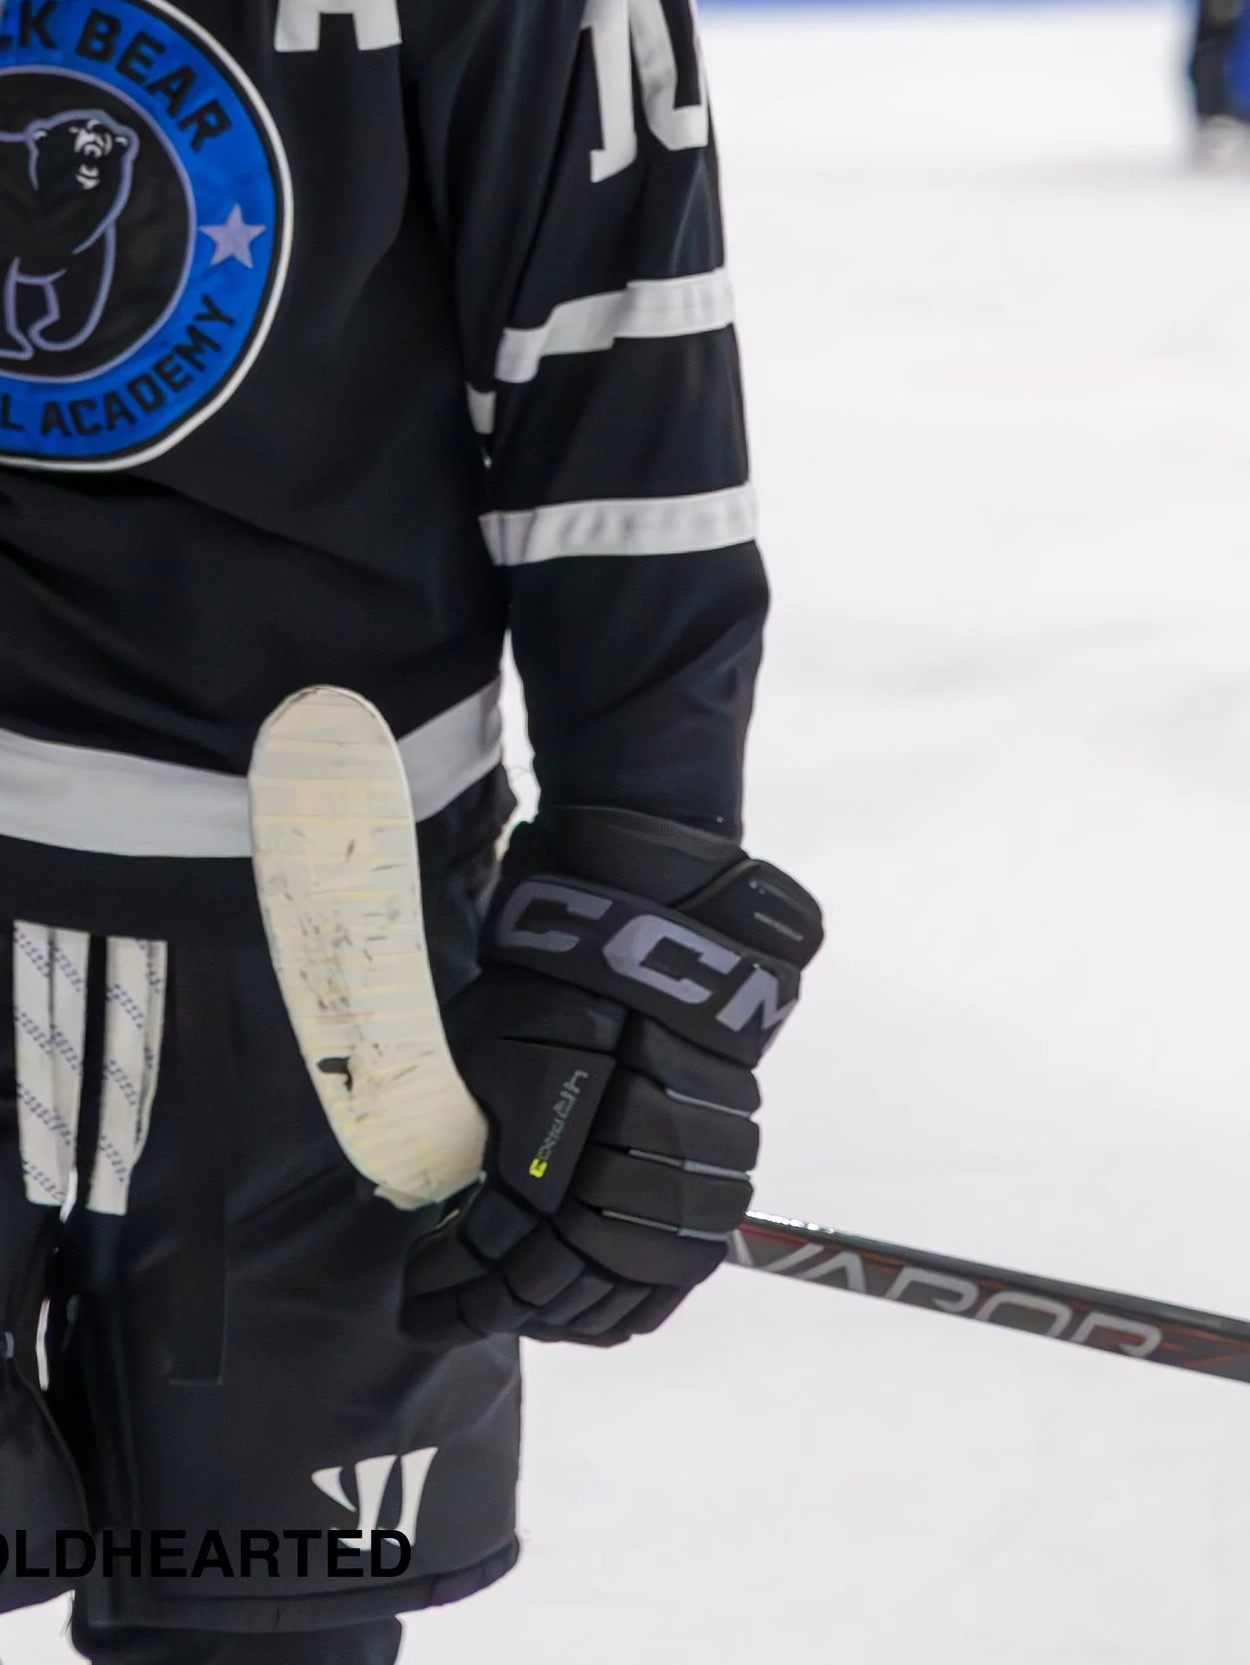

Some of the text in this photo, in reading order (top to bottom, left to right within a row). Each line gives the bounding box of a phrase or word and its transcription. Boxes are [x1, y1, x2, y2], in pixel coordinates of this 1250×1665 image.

[75, 7, 232, 152] BEAR
[40, 293, 235, 439] ACADEMY
[497, 880, 799, 1032] CCM
